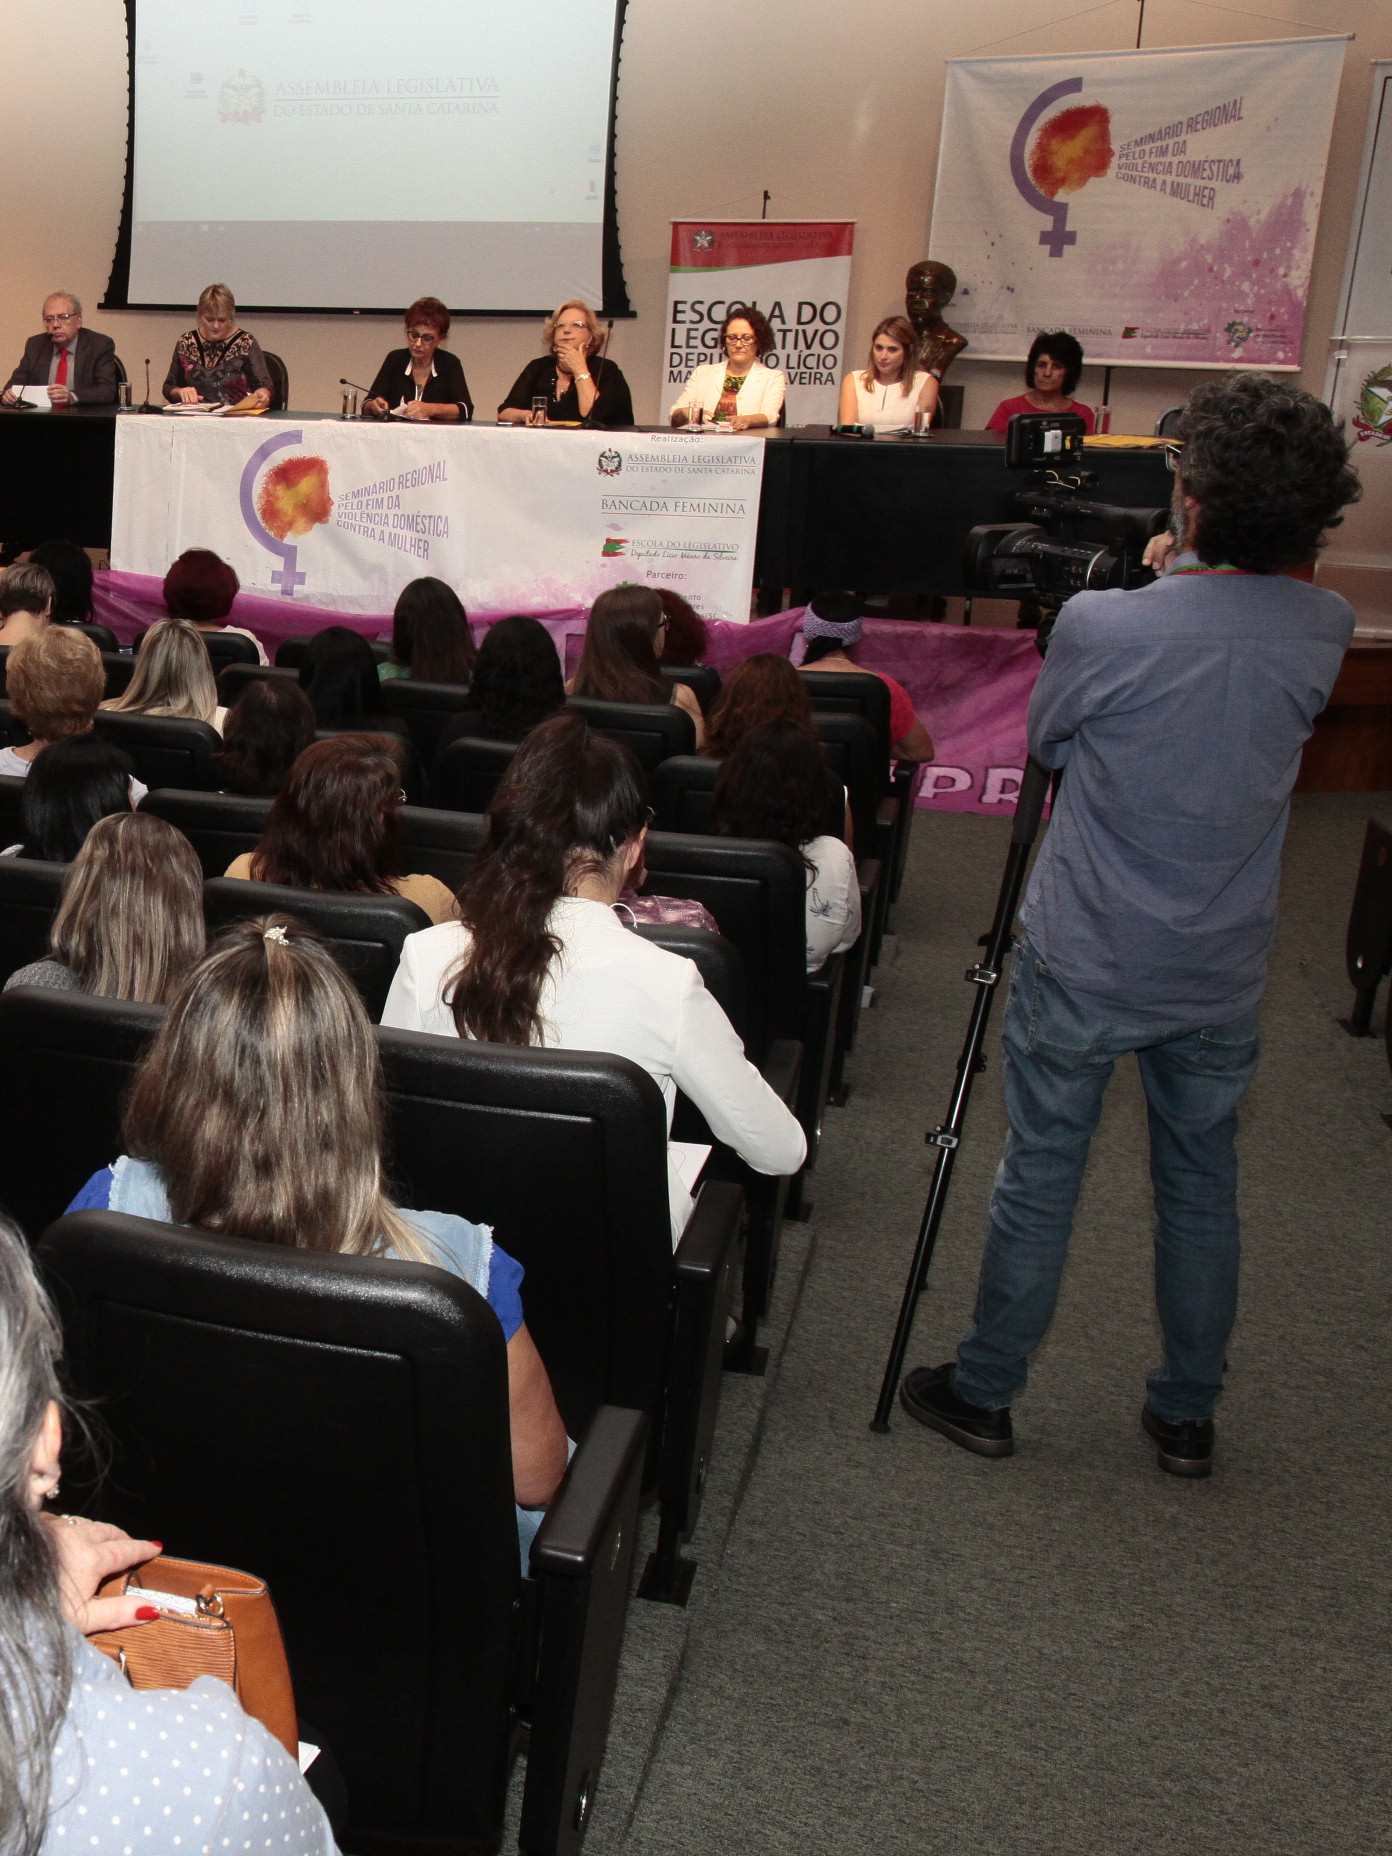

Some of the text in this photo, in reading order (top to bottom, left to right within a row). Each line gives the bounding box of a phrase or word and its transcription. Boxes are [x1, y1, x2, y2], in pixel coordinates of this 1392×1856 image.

[386, 77, 499, 94] LEGISLATIVA
[1119, 96, 1244, 153] SEMINÁRIO REGIONAL
[1118, 140, 1187, 161] PELO FIM DA
[1117, 155, 1242, 184] VIOLÊNCIA DOMÉSTICA
[1115, 171, 1216, 210] CONTRA A MULHER
[796, 300, 842, 326] DO
[785, 350, 838, 370] LÍCIO
[650, 434, 704, 445] Realização:
[627, 453, 756, 465] ASSEMBLEIA LEGISLATIVA
[337, 459, 448, 502] SEMINÁRIO REGIONAL
[625, 465, 756, 476] DO ESTADO DE SANTA CATARINA
[337, 494, 401, 511] PELO FIM DA
[601, 499, 746, 514] BANCADA FEMININA
[337, 510, 449, 539] VIOLÊNCIA DOMÉSTICA
[336, 519, 430, 561] CONTRA A MULHER
[631, 539, 739, 551] ESCOLA DO LEGISLATIVO
[646, 569, 688, 580] Parceiro:
